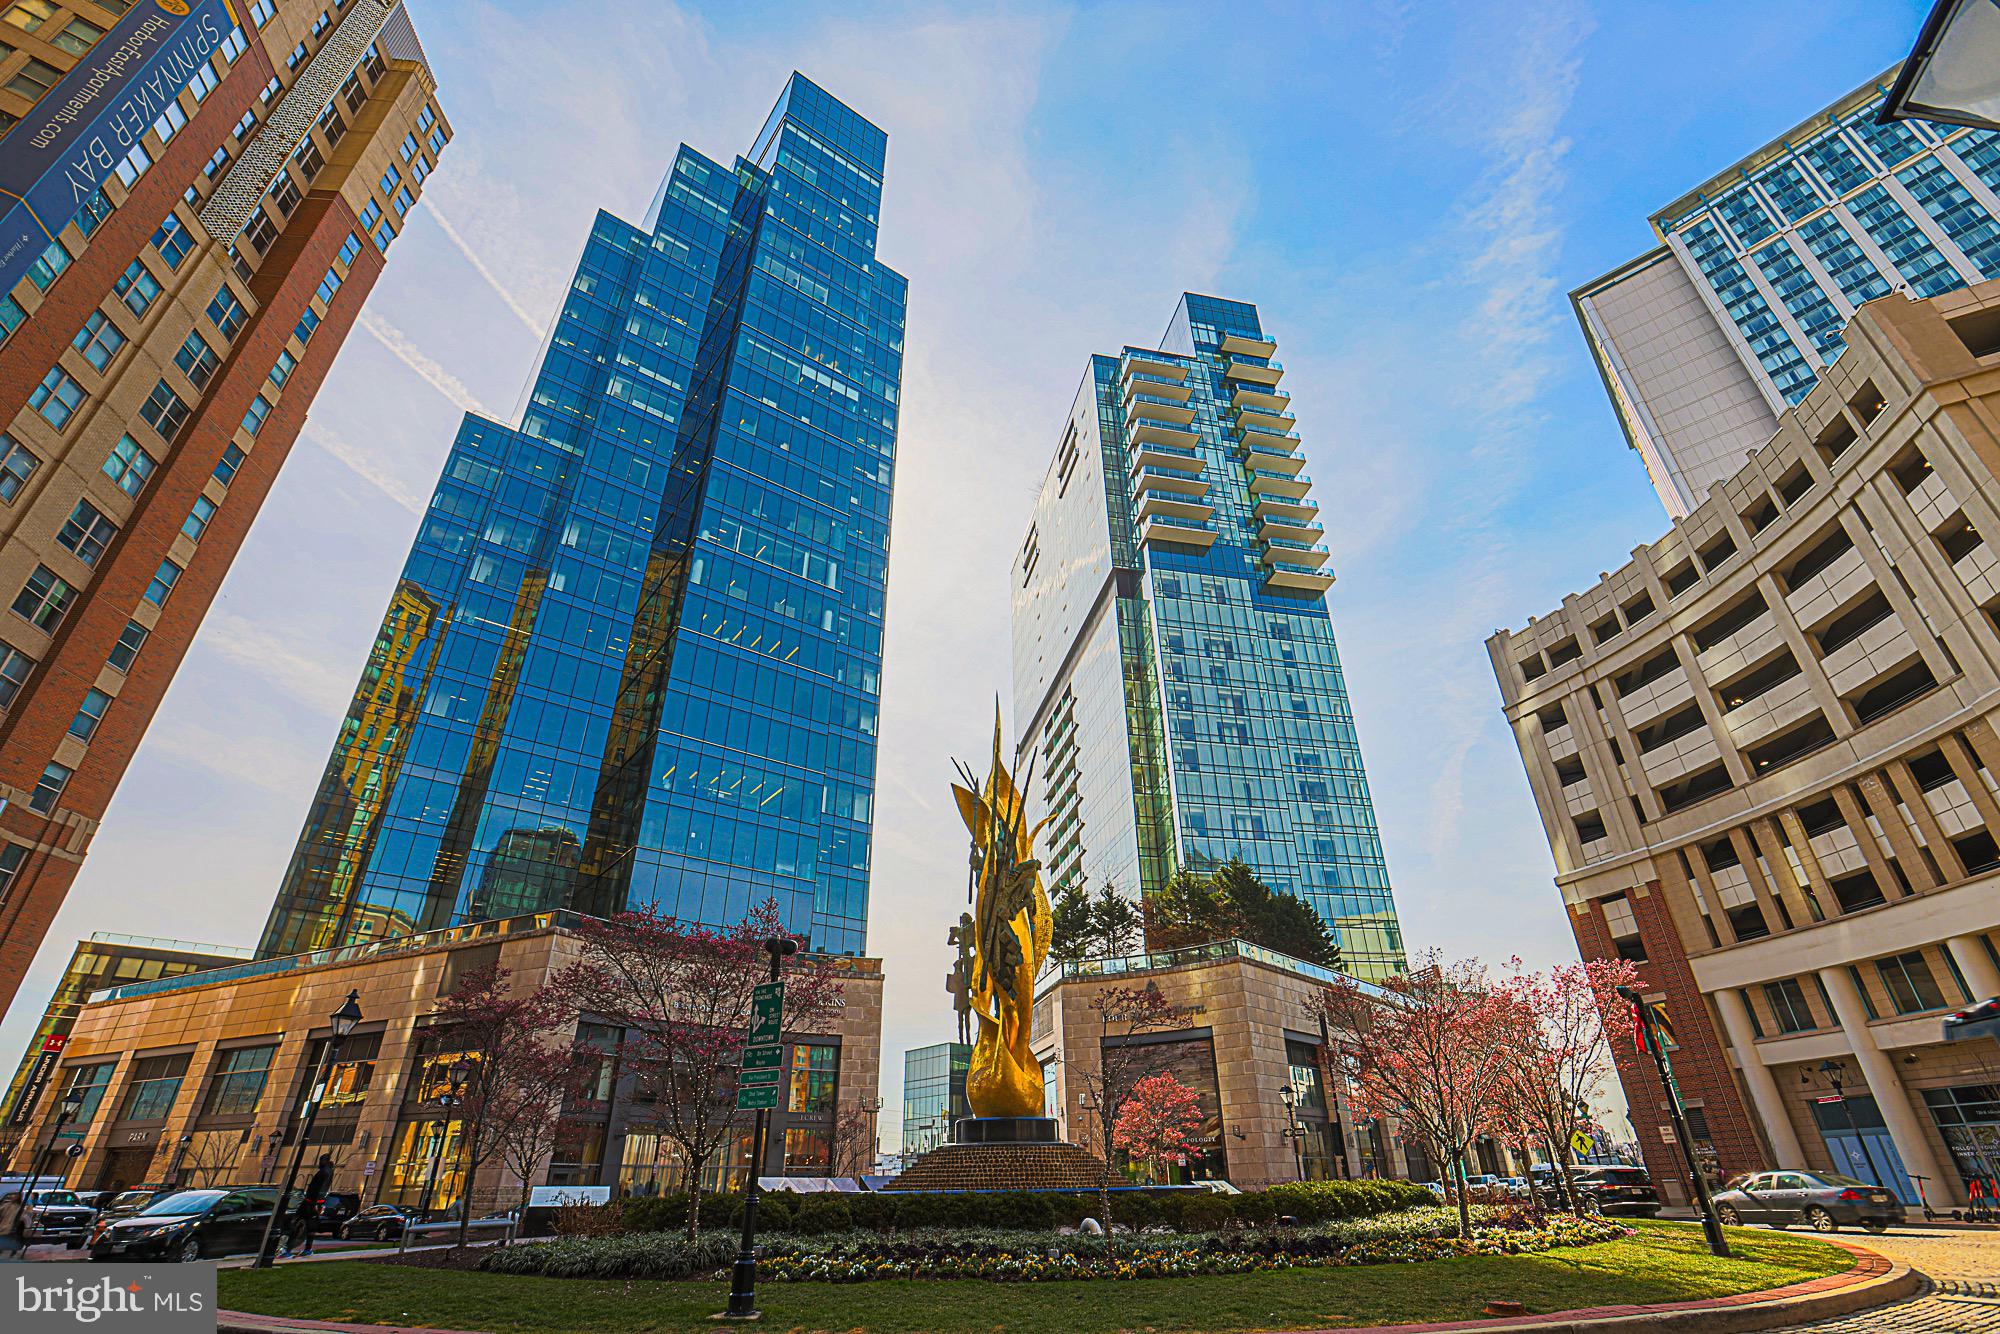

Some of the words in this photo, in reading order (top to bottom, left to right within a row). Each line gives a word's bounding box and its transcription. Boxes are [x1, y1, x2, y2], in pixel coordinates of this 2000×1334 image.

[30, 14, 170, 149] HarborEastApartments.com
[109, 14, 219, 146] SPINNAKER
[65, 137, 114, 203] BAY
[752, 1034, 774, 1043] DOWNTOWN
[35, 1055, 52, 1083] UNDER
[16, 1084, 38, 1122] ARMOUR
